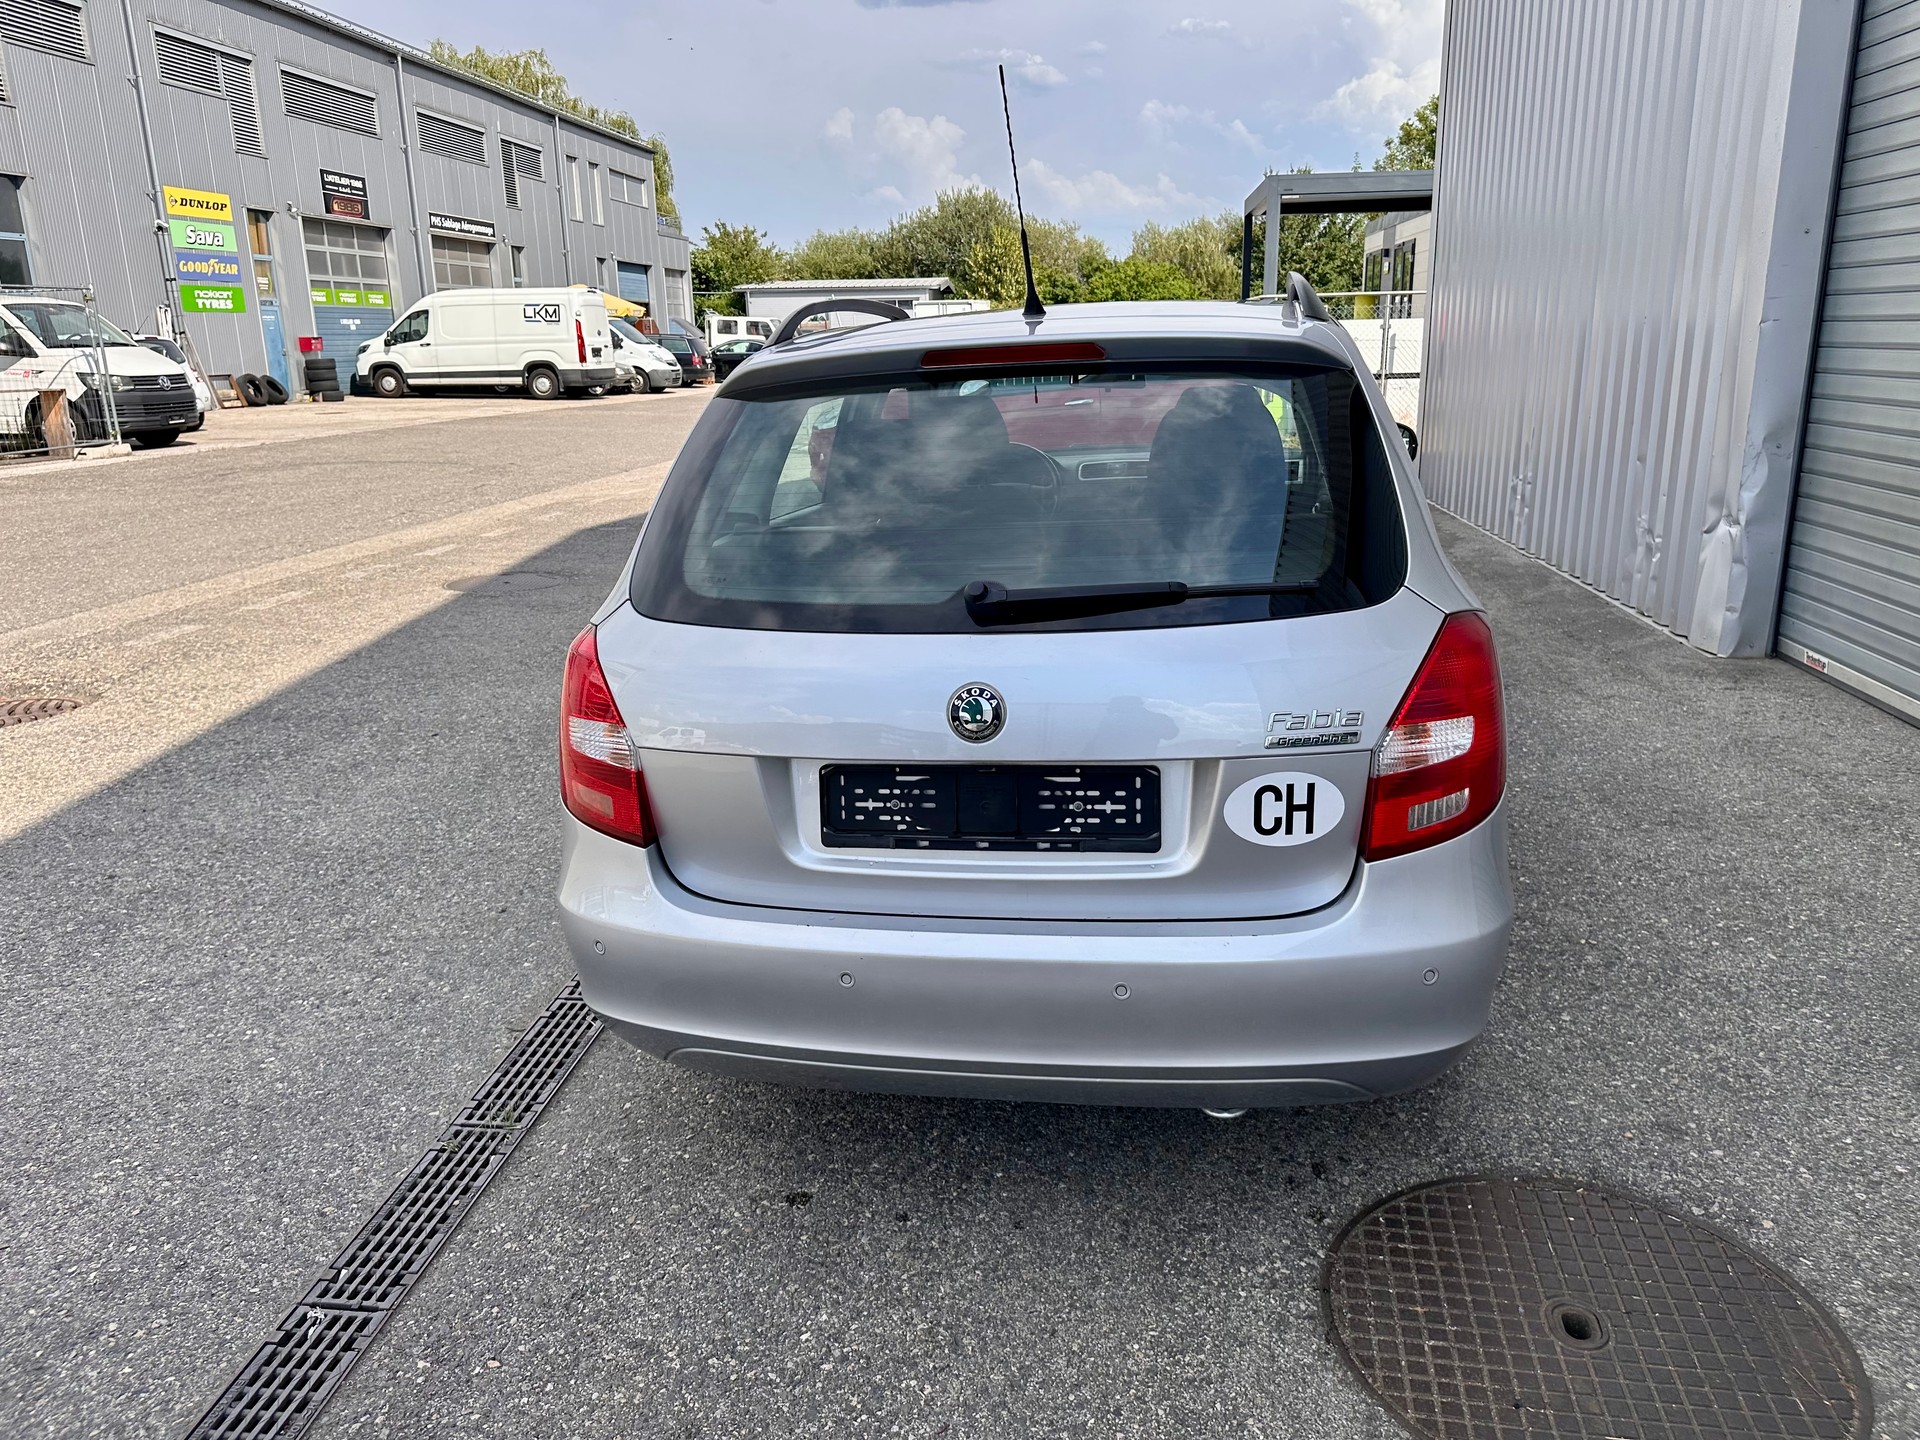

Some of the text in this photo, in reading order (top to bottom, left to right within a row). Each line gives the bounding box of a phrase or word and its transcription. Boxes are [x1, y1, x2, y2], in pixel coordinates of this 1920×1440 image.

[180, 197, 227, 211] DUNLOP
[334, 200, 360, 212] 1986
[186, 225, 224, 247] Sava
[179, 258, 238, 276] GOODYEAR
[195, 298, 233, 309] TYRES
[523, 305, 559, 321] LKM
[1266, 708, 1364, 732] Fabia
[1253, 782, 1316, 836] CH
